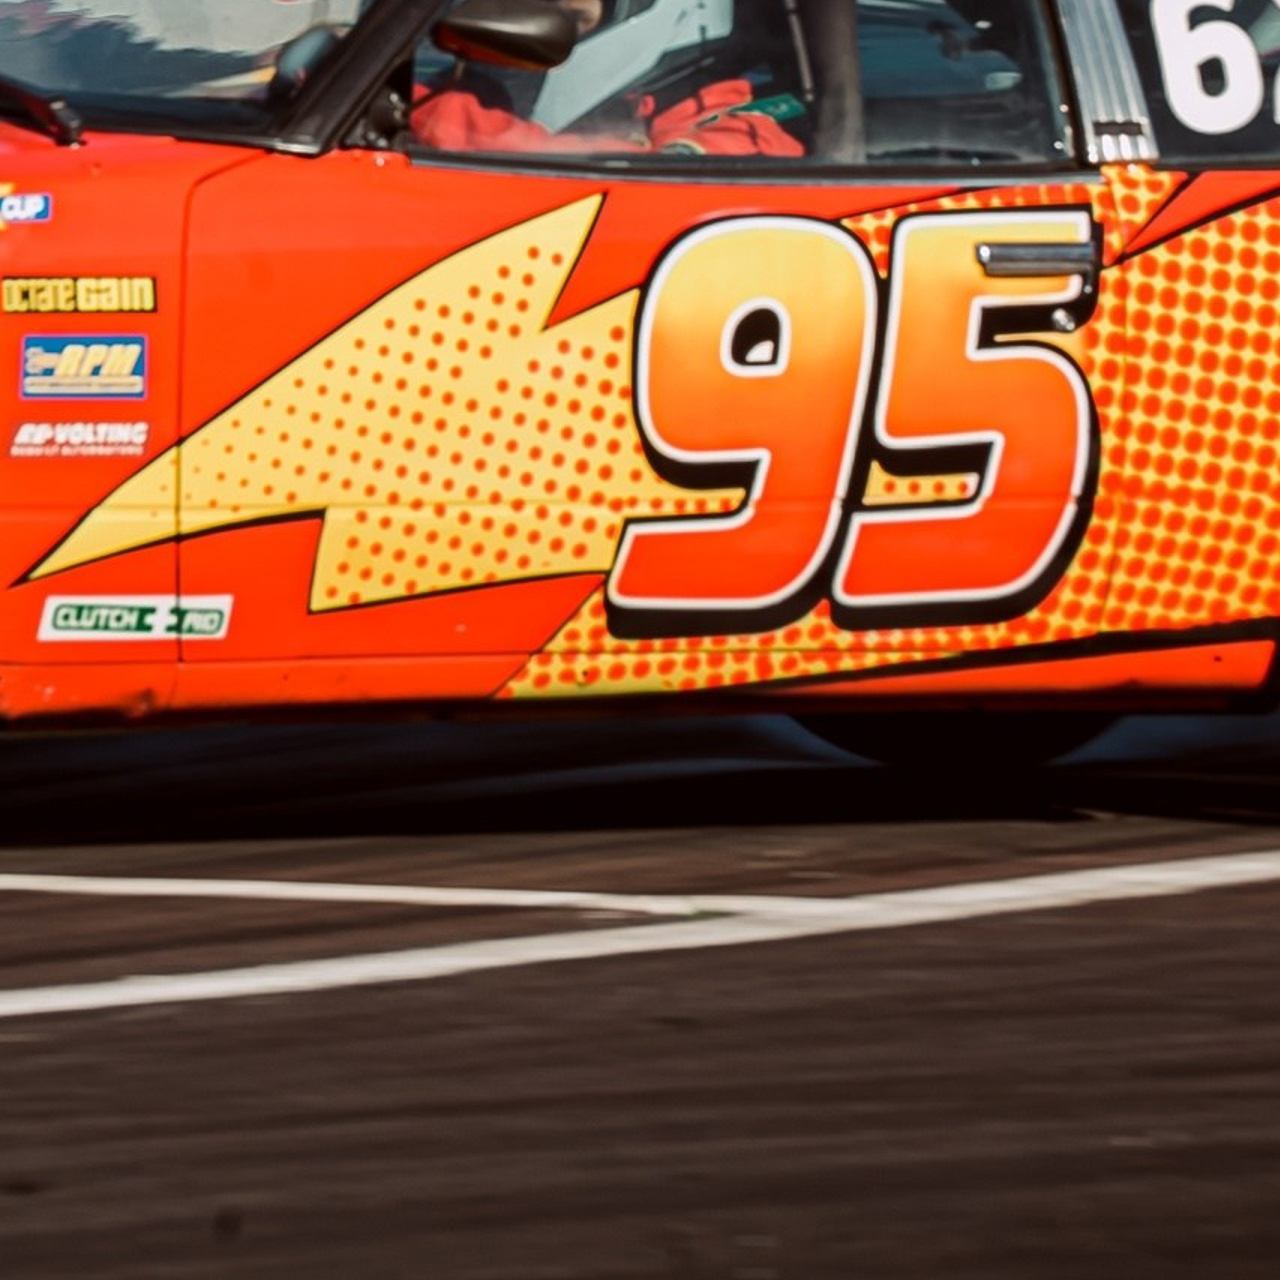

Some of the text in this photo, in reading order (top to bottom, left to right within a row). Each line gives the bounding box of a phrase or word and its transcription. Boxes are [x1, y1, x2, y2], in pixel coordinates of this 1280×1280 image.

[1, 194, 45, 221] CUP
[56, 343, 142, 377] RPM
[607, 206, 1100, 634] 95
[56, 606, 220, 633] CLUTCH AID
